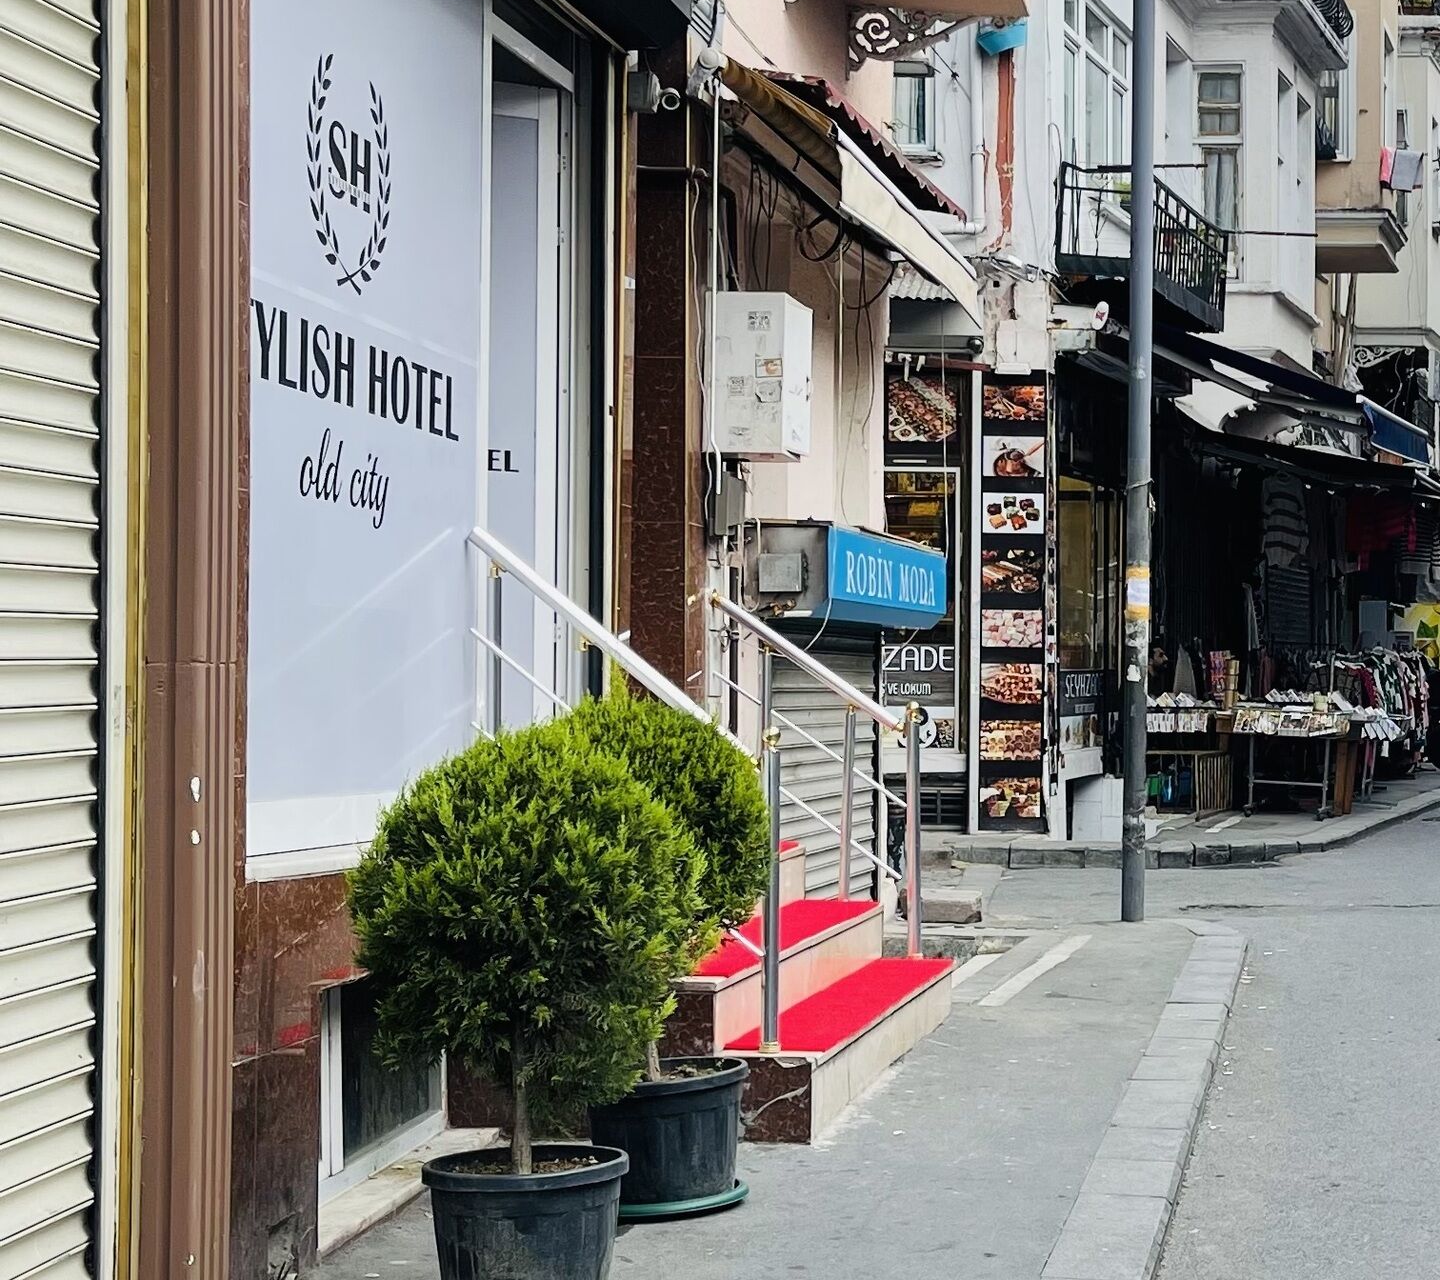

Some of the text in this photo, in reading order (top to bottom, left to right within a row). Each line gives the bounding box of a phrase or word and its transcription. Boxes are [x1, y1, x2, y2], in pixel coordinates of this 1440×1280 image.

[328, 120, 371, 214] SH
[250, 298, 459, 442] YLISH HOTEL
[299, 427, 390, 530] old city
[846, 548, 936, 607] ROBİN MODA
[881, 646, 955, 672] ZADE
[887, 682, 898, 695] VE
[900, 682, 932, 696] LOKUM
